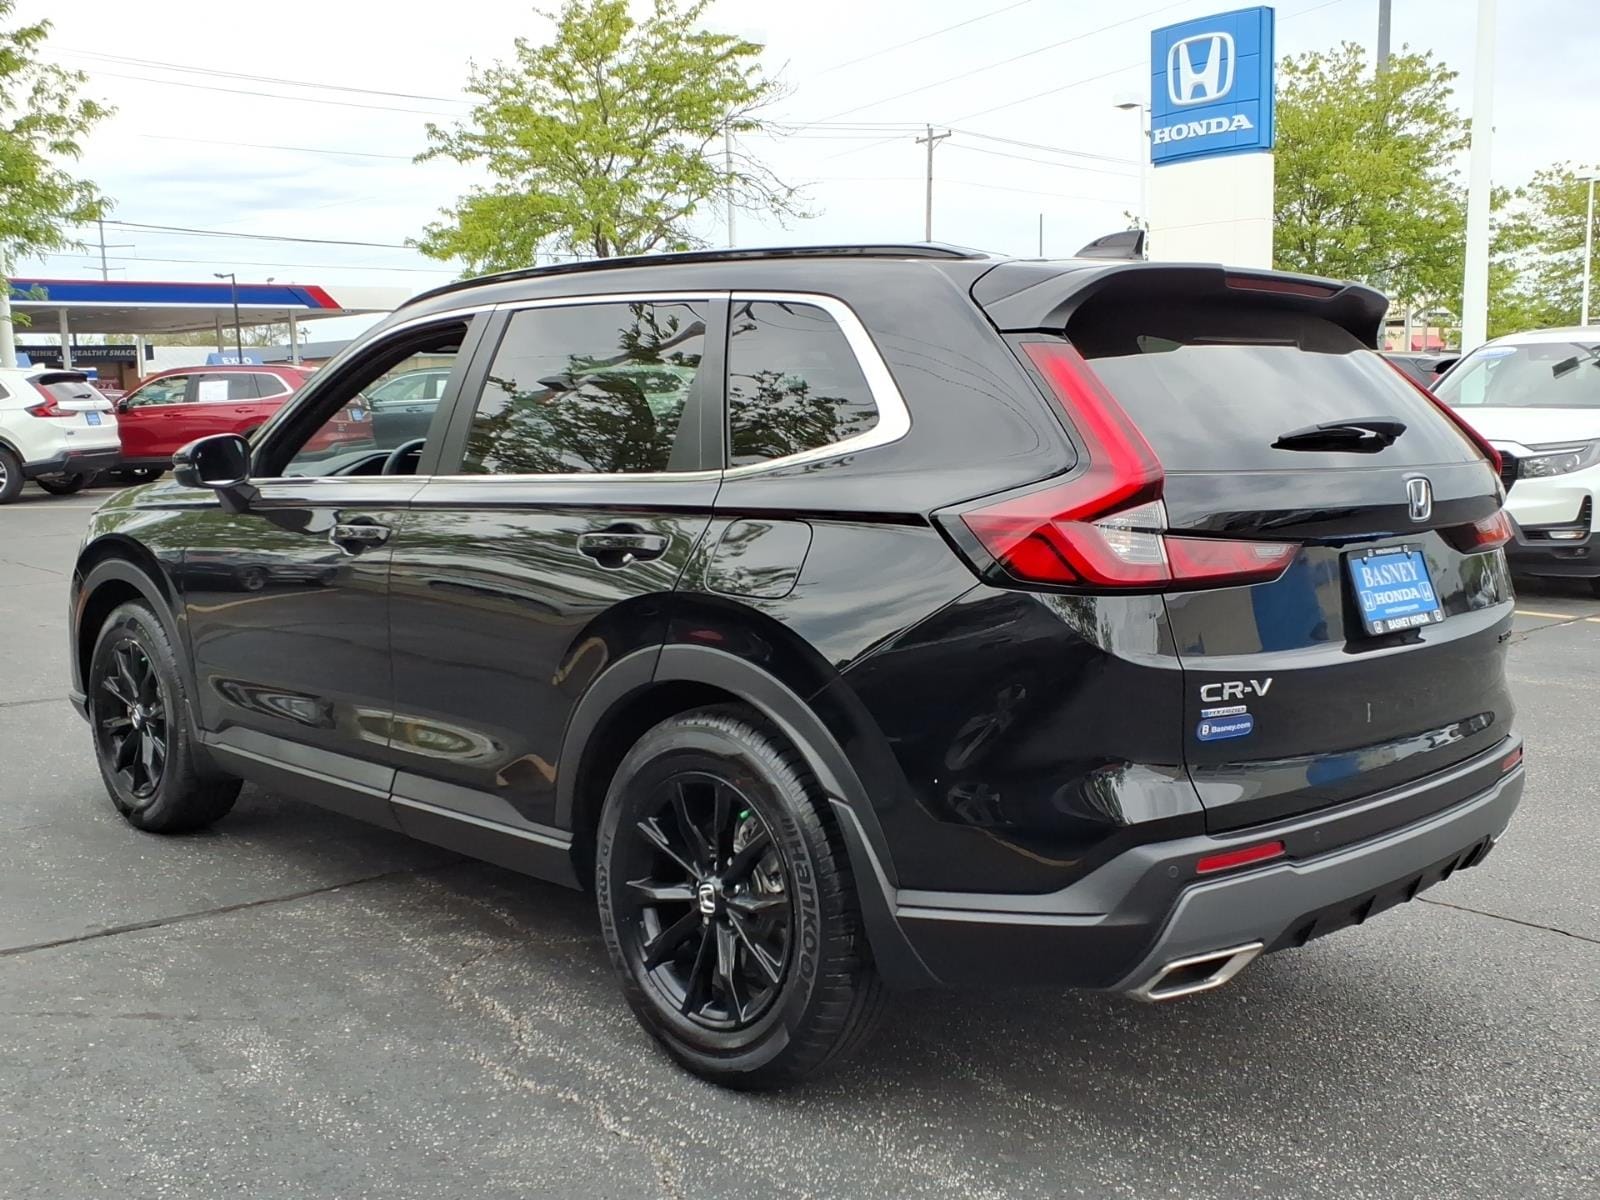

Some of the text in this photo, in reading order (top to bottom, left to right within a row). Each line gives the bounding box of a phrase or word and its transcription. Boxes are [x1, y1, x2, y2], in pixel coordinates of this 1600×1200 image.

[1153, 114, 1254, 145] HONDA
[1361, 561, 1418, 588] BASNEY
[1374, 587, 1421, 605] HONDA
[1200, 678, 1272, 702] CR-V
